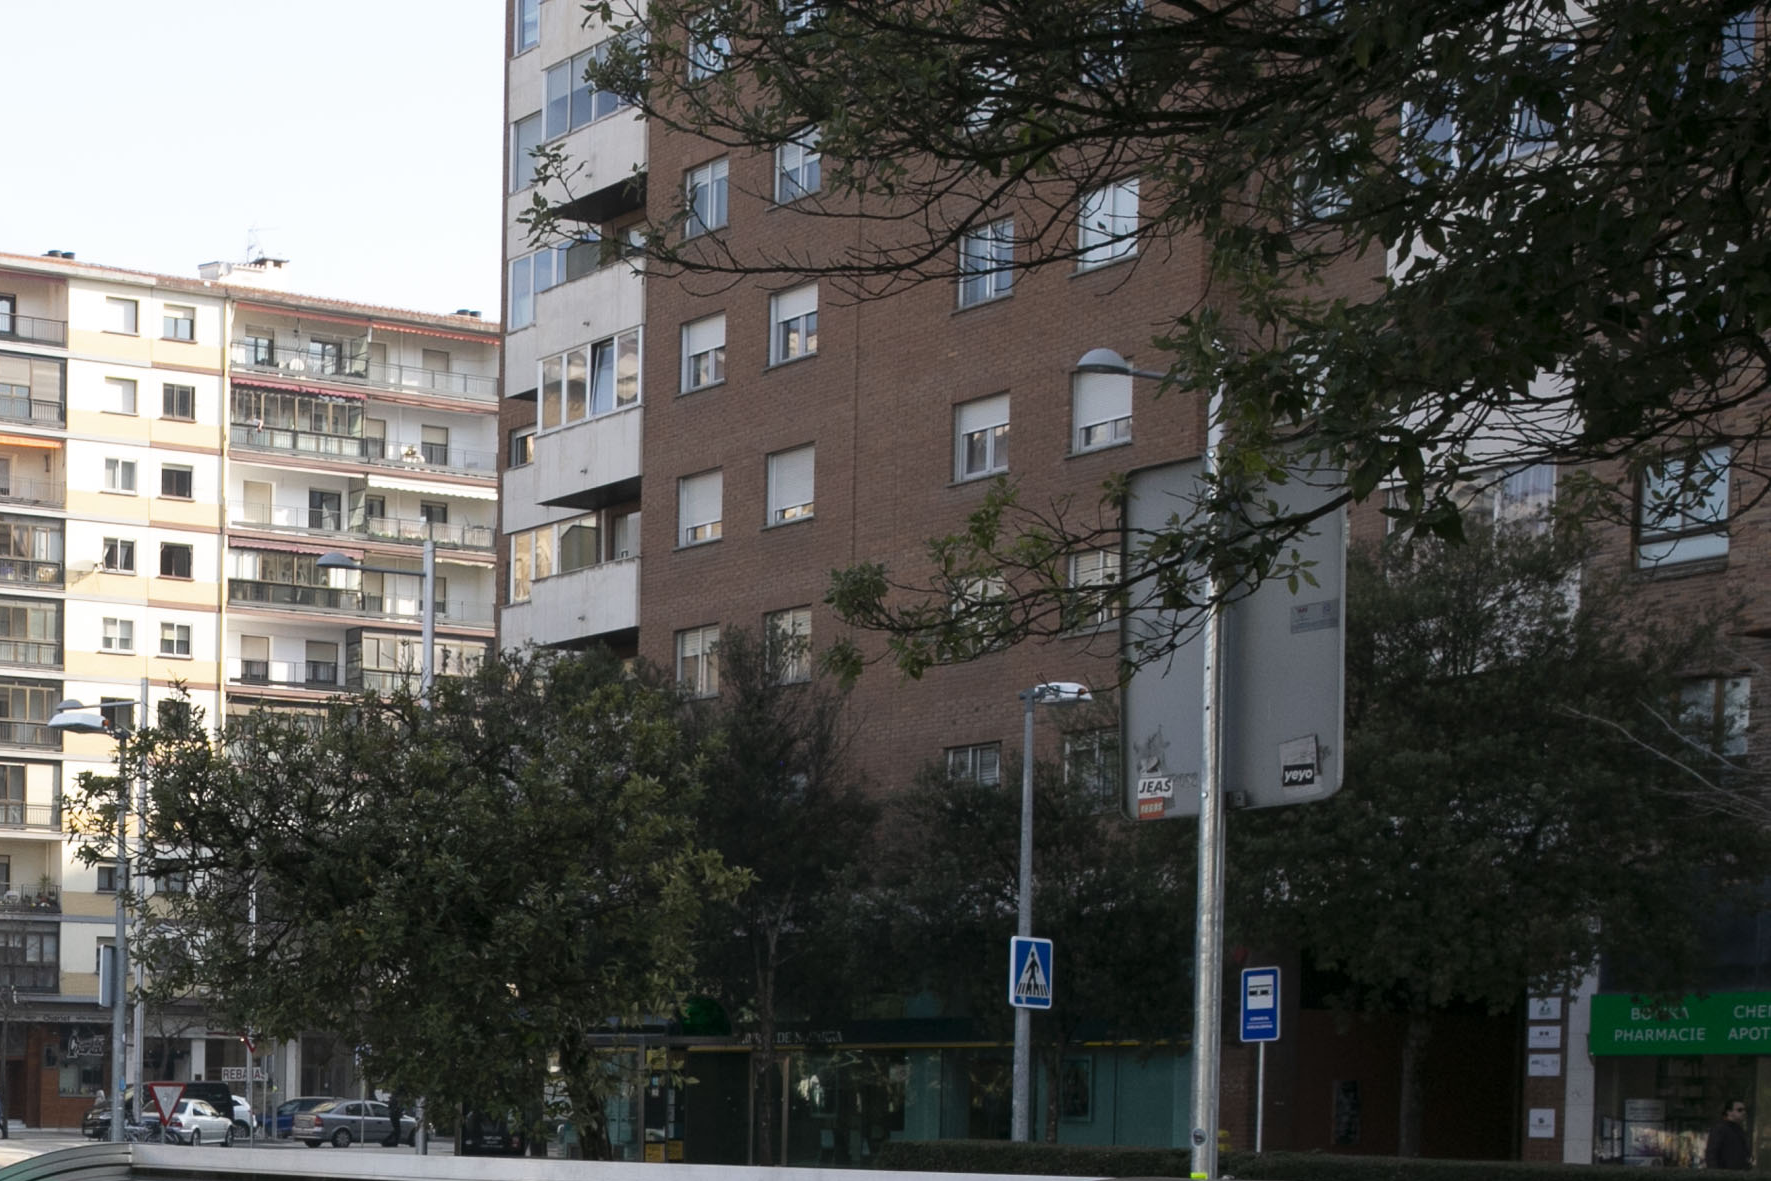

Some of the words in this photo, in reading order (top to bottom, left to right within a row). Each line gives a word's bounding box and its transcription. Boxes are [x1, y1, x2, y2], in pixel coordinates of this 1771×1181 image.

[1284, 767, 1314, 784] yeyo
[1139, 779, 1172, 794] JEAS
[1733, 1004, 1771, 1019] CHE
[1614, 1026, 1707, 1042] PHARMACIE
